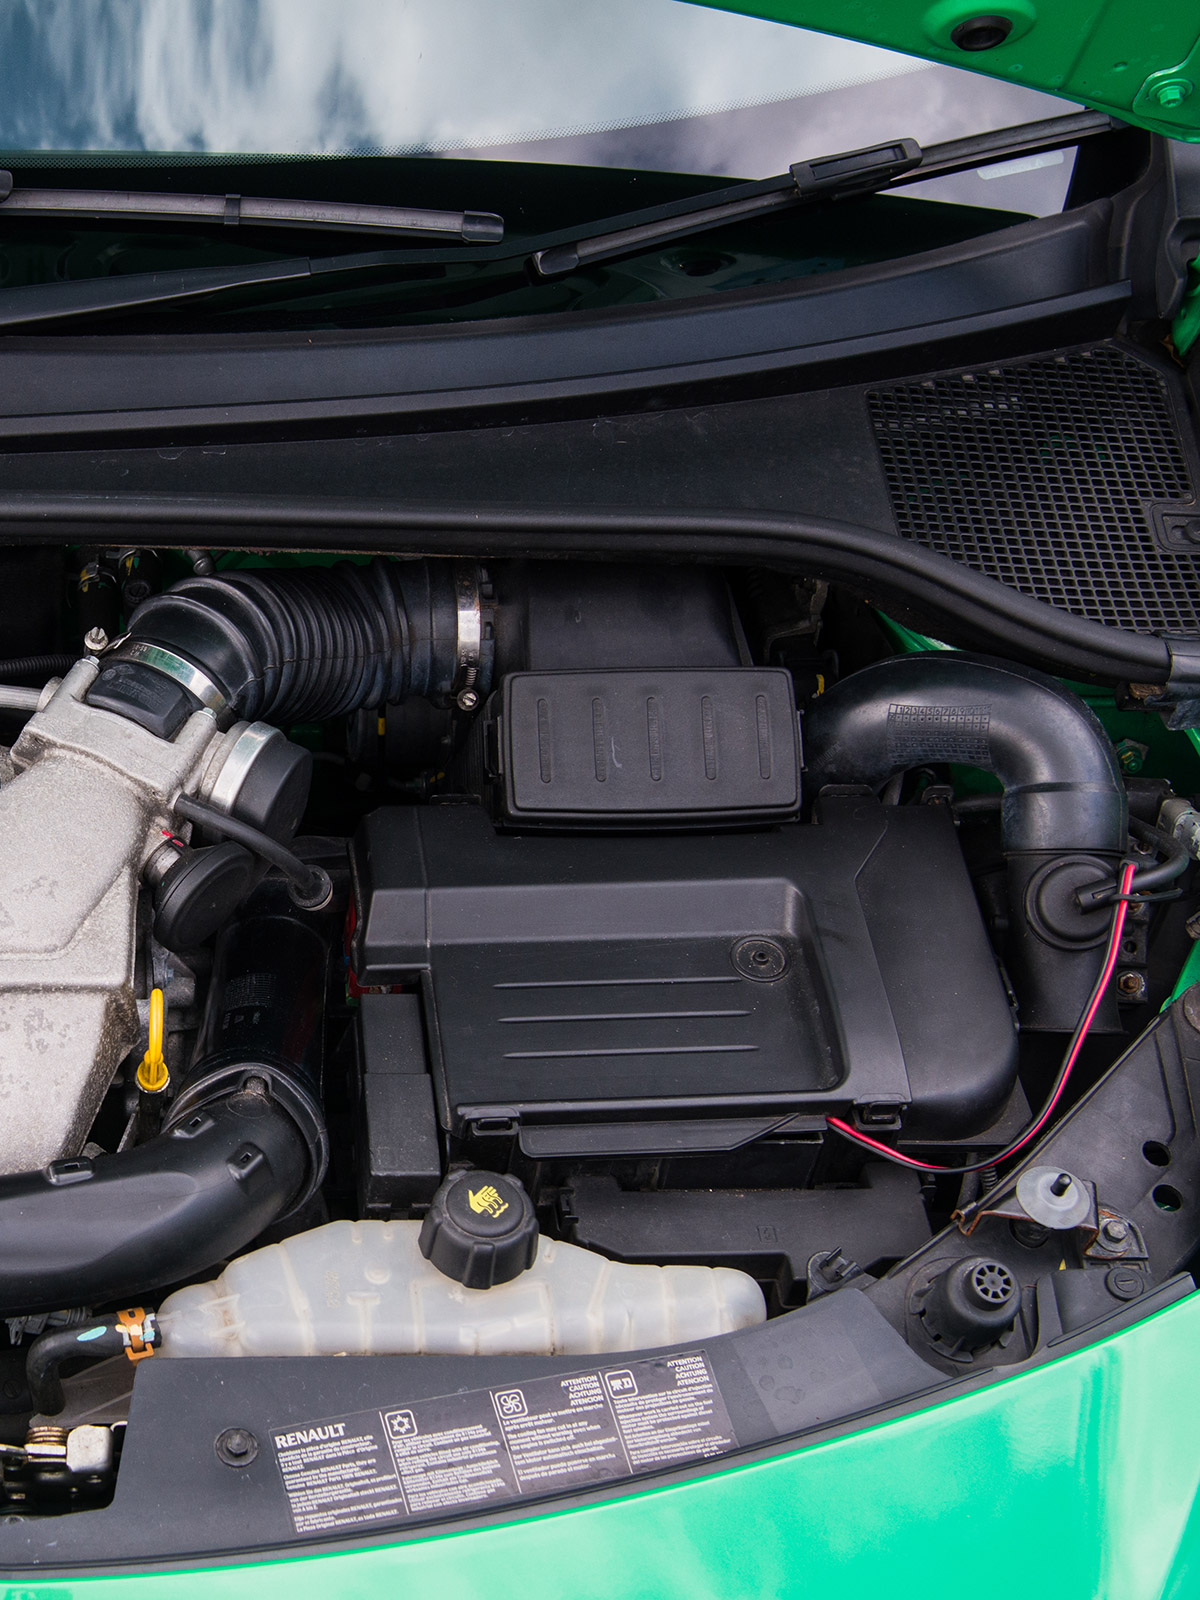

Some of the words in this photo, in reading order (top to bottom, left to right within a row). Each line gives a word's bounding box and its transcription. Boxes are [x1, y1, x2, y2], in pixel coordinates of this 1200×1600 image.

[667, 1356, 702, 1366] ATTENTION
[675, 1362, 704, 1372] CAUTION
[676, 1369, 707, 1378] ACHTUNG
[561, 1375, 597, 1386] ATTENTION
[677, 1375, 709, 1385] ATENCION
[569, 1382, 599, 1391] CAUTION
[569, 1388, 601, 1398] ACHTUNG
[570, 1395, 603, 1405] ATENCION
[275, 1423, 345, 1448] RENAULT
